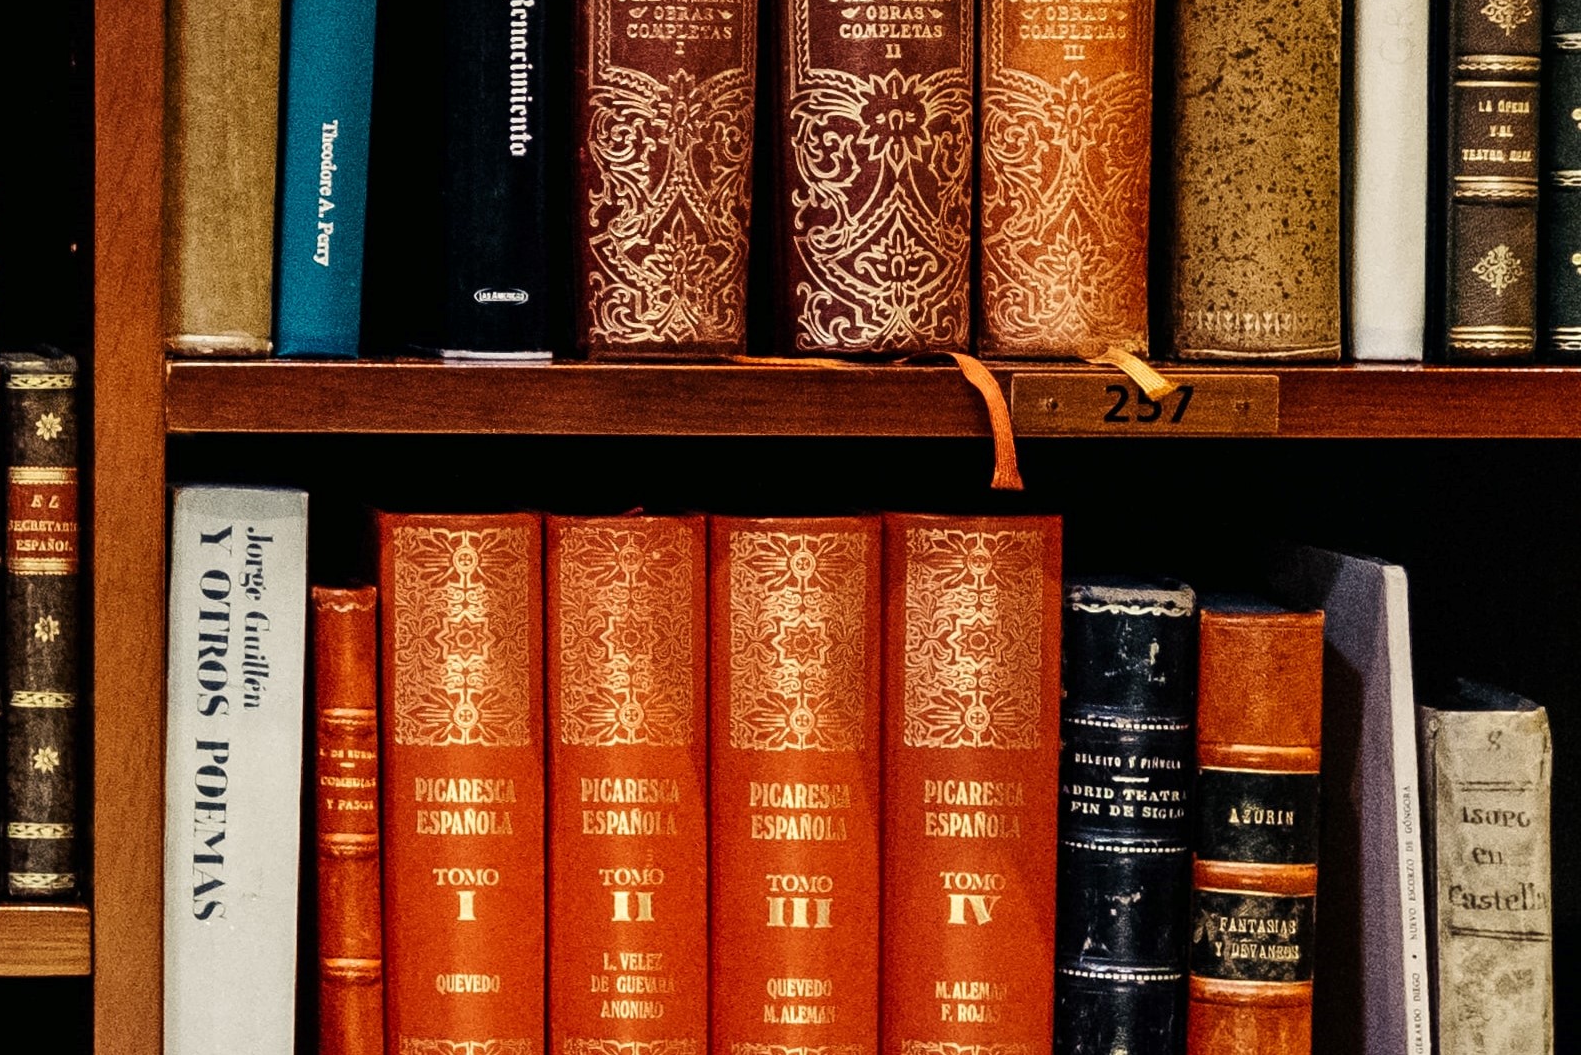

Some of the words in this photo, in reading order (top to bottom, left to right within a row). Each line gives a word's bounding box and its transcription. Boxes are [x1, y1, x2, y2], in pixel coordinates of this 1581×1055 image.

[865, 5, 925, 21] OBRAS
[1045, 5, 1108, 21] OBRAS
[626, 23, 733, 40] COMPLETAS
[838, 23, 943, 39] COMPLETAS
[1018, 23, 1127, 41] COMPLETAS
[319, 119, 339, 196] Theodore
[318, 197, 336, 218] A.
[313, 221, 334, 267] Perry
[199, 525, 234, 557] Y
[239, 525, 274, 602] Jorge
[196, 568, 233, 717] OTROS
[240, 610, 270, 712] Guillén
[415, 777, 517, 804] PICARESCA
[580, 777, 680, 804] PICARESCA
[748, 781, 852, 810] PICARESCA
[923, 779, 1025, 808] PICARESCA
[417, 807, 513, 835] ESPAÑOLA
[582, 807, 677, 835] ESPAÑOLA
[1070, 800, 1101, 816] FIN
[1109, 804, 1135, 818] DE
[1141, 807, 1185, 821] SIGLO
[191, 737, 231, 923] POEMAS
[751, 812, 848, 842] ESPAÑOLA
[924, 810, 1022, 839] ESPAÑOLA
[432, 867, 500, 887] TOMO
[599, 867, 665, 887] TOMO
[765, 873, 834, 894] TOMO
[939, 871, 1007, 891] TOMO
[611, 891, 655, 922] II
[765, 896, 834, 929] III
[947, 894, 1003, 926] IV
[1218, 916, 1298, 935] FANTASIAS
[435, 974, 501, 995] QUEVEDO
[590, 975, 609, 993] DE
[615, 975, 676, 994] GUEVARA
[766, 978, 833, 1000] QUEVEDO
[600, 1000, 664, 1019] ANONIMO
